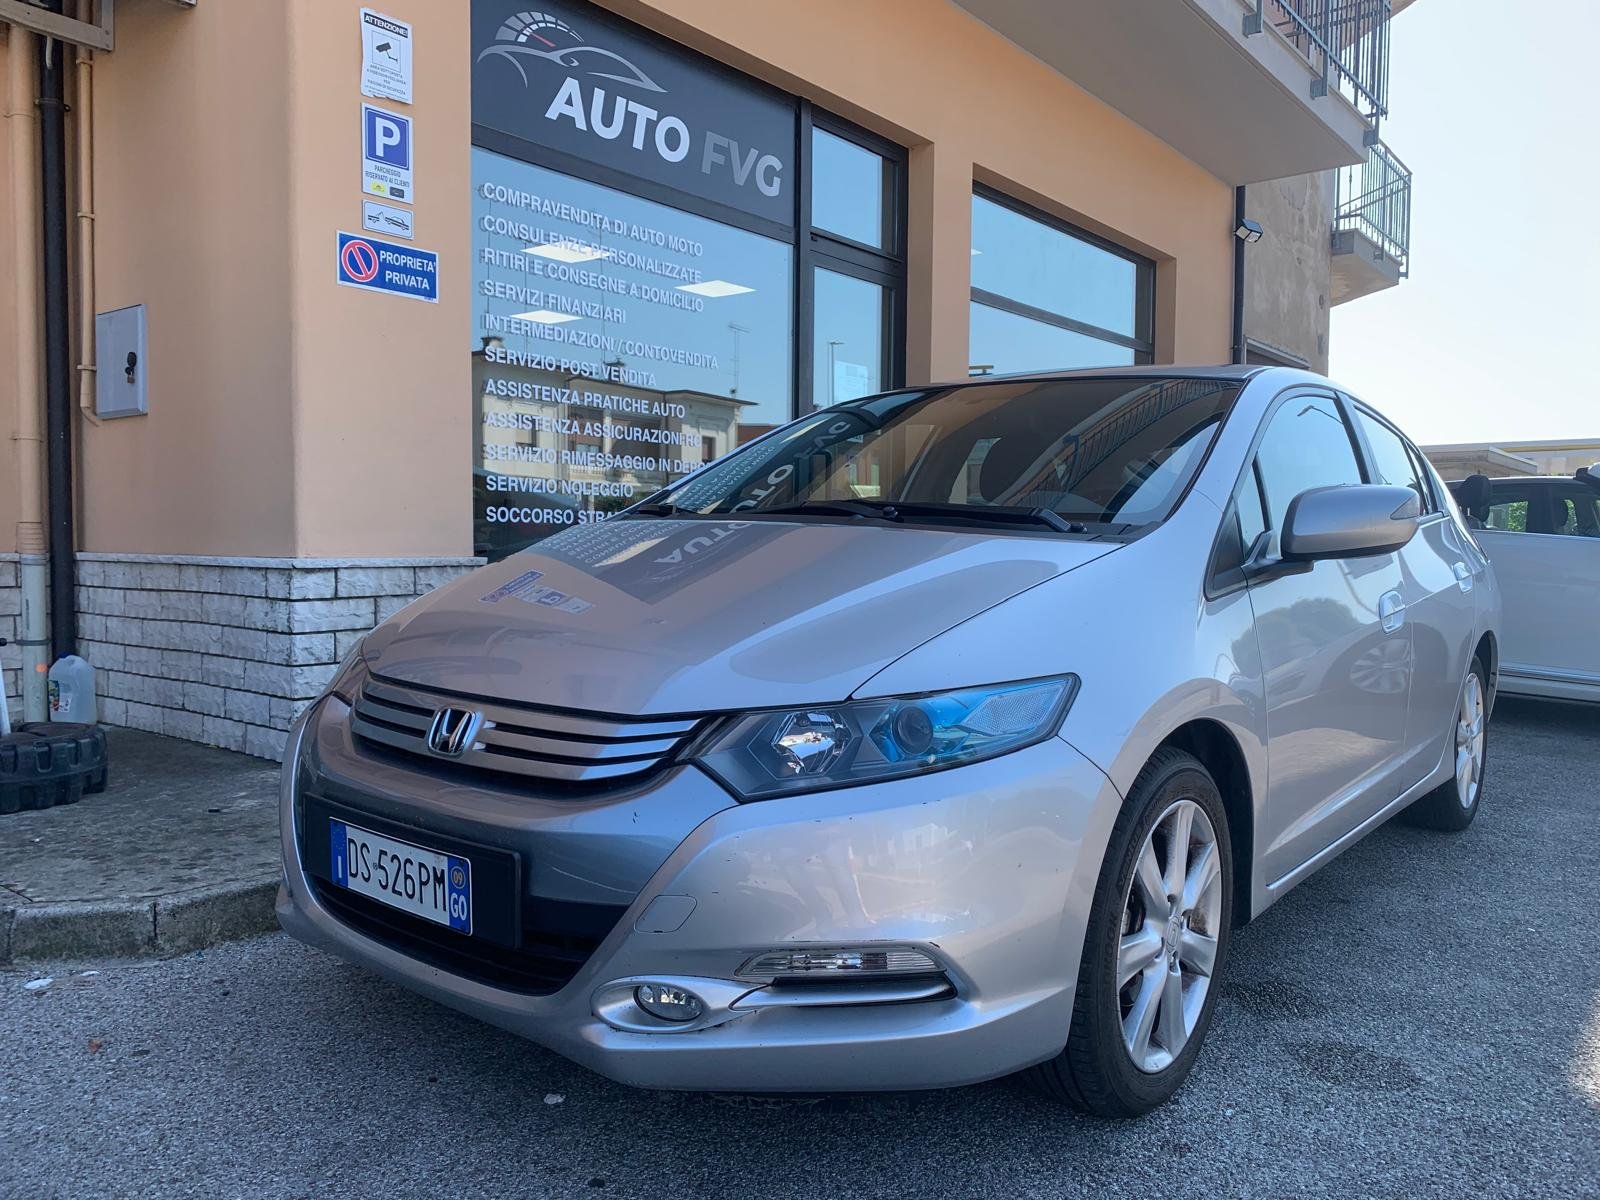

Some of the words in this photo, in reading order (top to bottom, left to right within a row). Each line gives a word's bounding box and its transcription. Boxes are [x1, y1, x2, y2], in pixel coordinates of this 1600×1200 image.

[365, 15, 408, 37] ATTENZIONE!
[375, 116, 401, 157] P
[545, 76, 690, 164] AUTO
[700, 131, 784, 197] FVG
[482, 182, 611, 232] COMPRAVENDITA
[614, 219, 628, 236] DI
[631, 223, 666, 248] AUTO
[668, 233, 704, 258] MOTO
[379, 250, 436, 273] PROPRIETA'
[482, 215, 588, 256] CONSULENZE
[592, 242, 703, 284] PERSONALIZZATE
[385, 270, 430, 290] PRIVATA
[483, 248, 530, 273] RITIRI
[534, 258, 544, 275] E
[547, 262, 627, 295] CONSEGNE
[629, 282, 640, 297] A
[640, 284, 705, 313] DOMICILIO
[483, 279, 545, 307] SERVIZI
[548, 293, 627, 325] FINANZIARI
[485, 313, 616, 353] INTERMEDIAZIONI
[625, 340, 719, 369] CONTOVENDITA
[485, 346, 556, 373] SERVIZIO
[561, 358, 598, 378] POST
[602, 362, 657, 387] VENDITA
[485, 378, 581, 406] ASSISTENZA
[583, 391, 649, 415] PRATICHE
[652, 401, 686, 420] AUTO
[485, 411, 581, 436] ASSISTENZA
[485, 445, 557, 465] SERVIZIO
[562, 451, 655, 472] RIMESSAGGIO
[658, 458, 671, 472] IN
[486, 476, 557, 494] SERVIZIO
[562, 481, 634, 499] NOLEGGIO
[486, 506, 574, 525] SOCCORSO
[450, 892, 468, 921] GO
